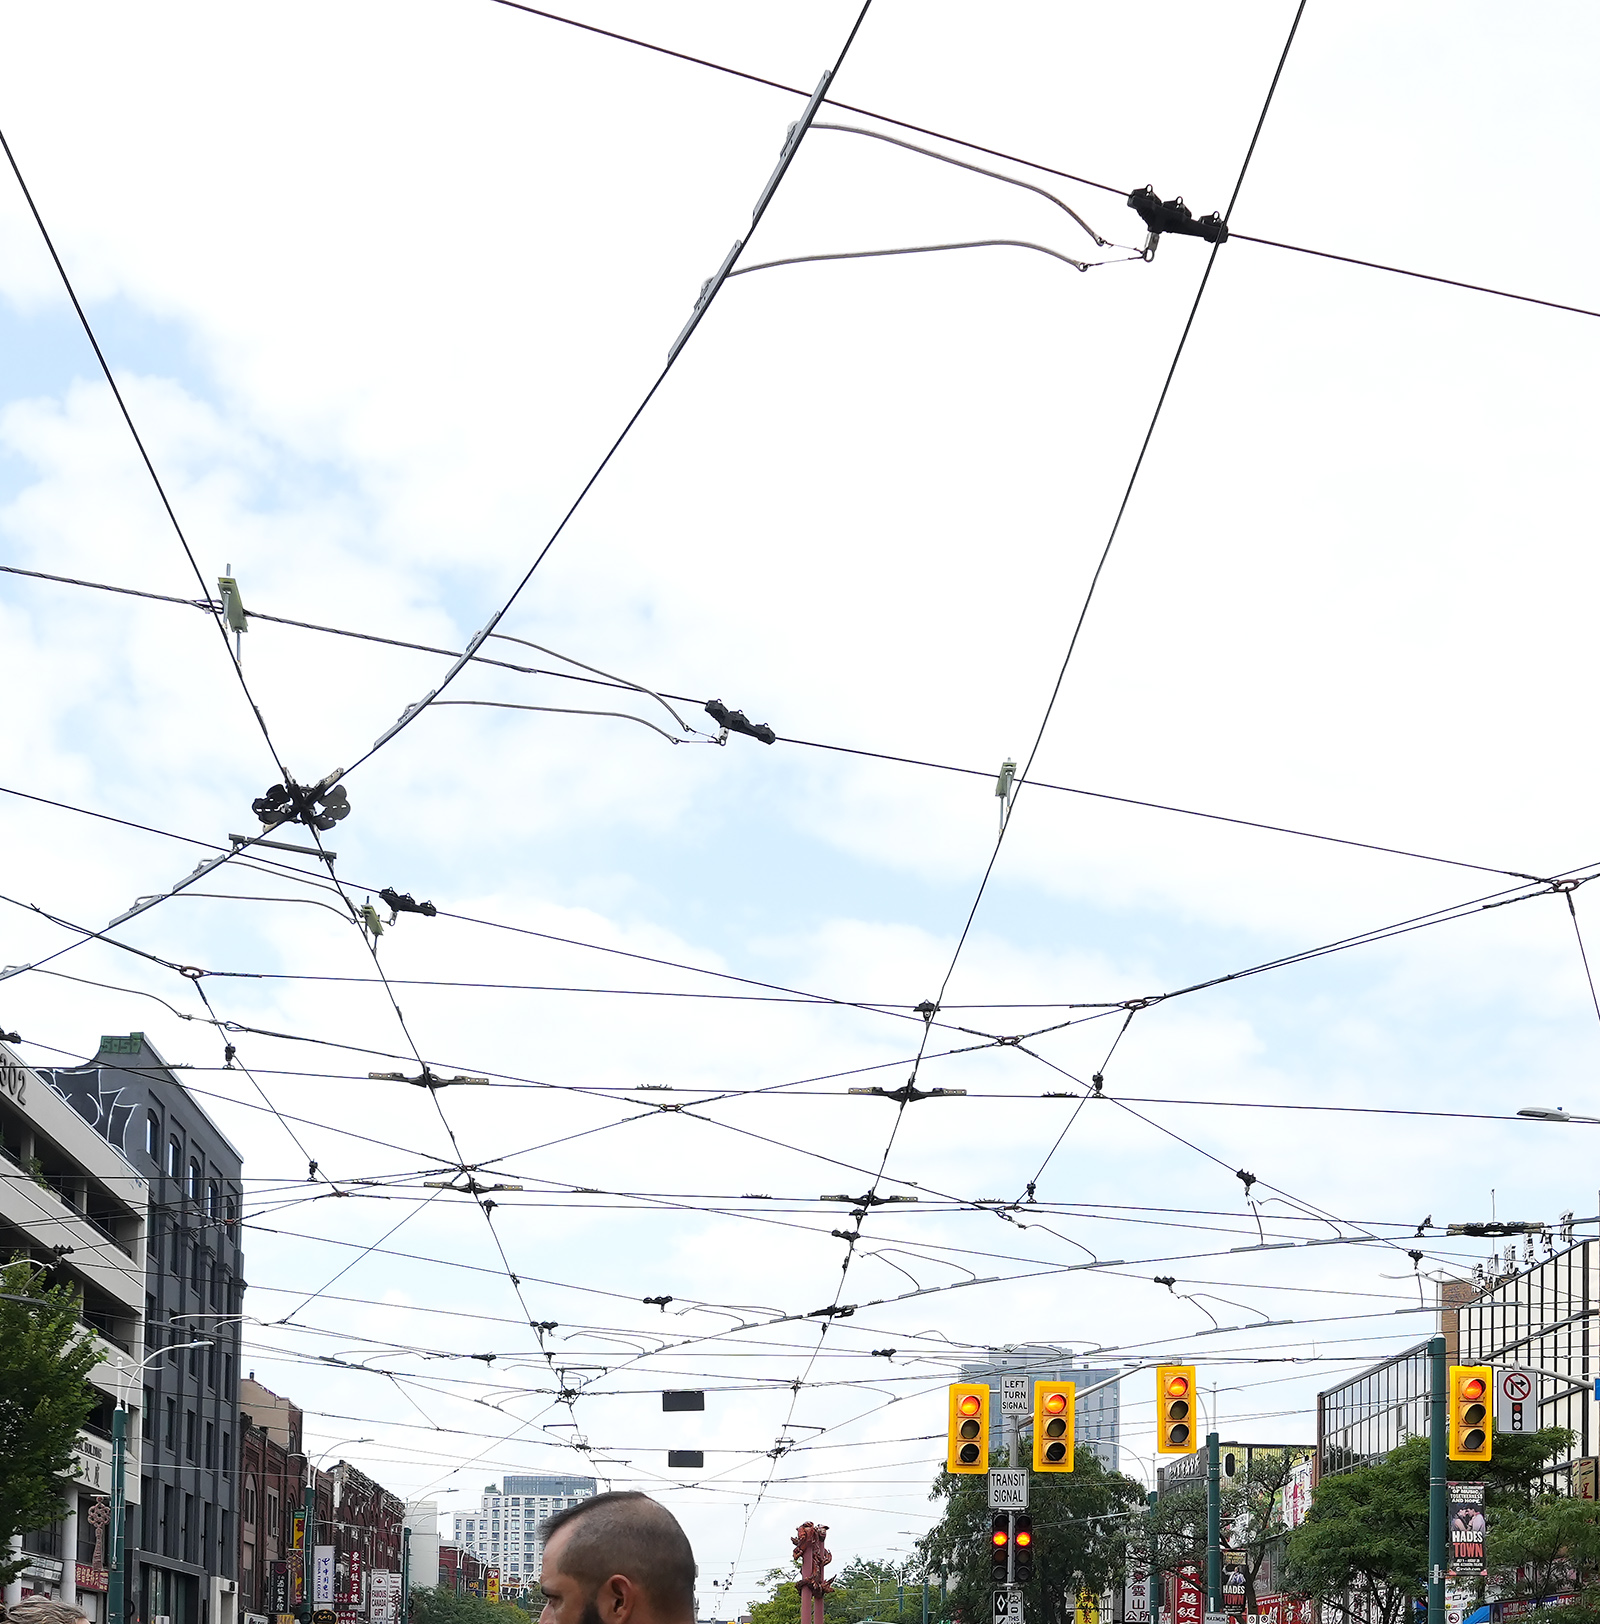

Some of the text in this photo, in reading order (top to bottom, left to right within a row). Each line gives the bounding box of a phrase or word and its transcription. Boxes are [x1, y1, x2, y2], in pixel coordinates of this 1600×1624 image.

[0, 1053, 26, 1105] 302
[1004, 1391, 1026, 1399] TURN
[991, 1473, 1025, 1487] TRANSIT
[993, 1490, 1023, 1502] SIGNAL
[1452, 1531, 1483, 1543] HADES
[1453, 1542, 1483, 1558] TOWN
[1223, 1585, 1246, 1594] HADES
[372, 1599, 386, 1607] CANADA
[1224, 1594, 1245, 1605] TOWN
[374, 1608, 384, 1616] GIFT
